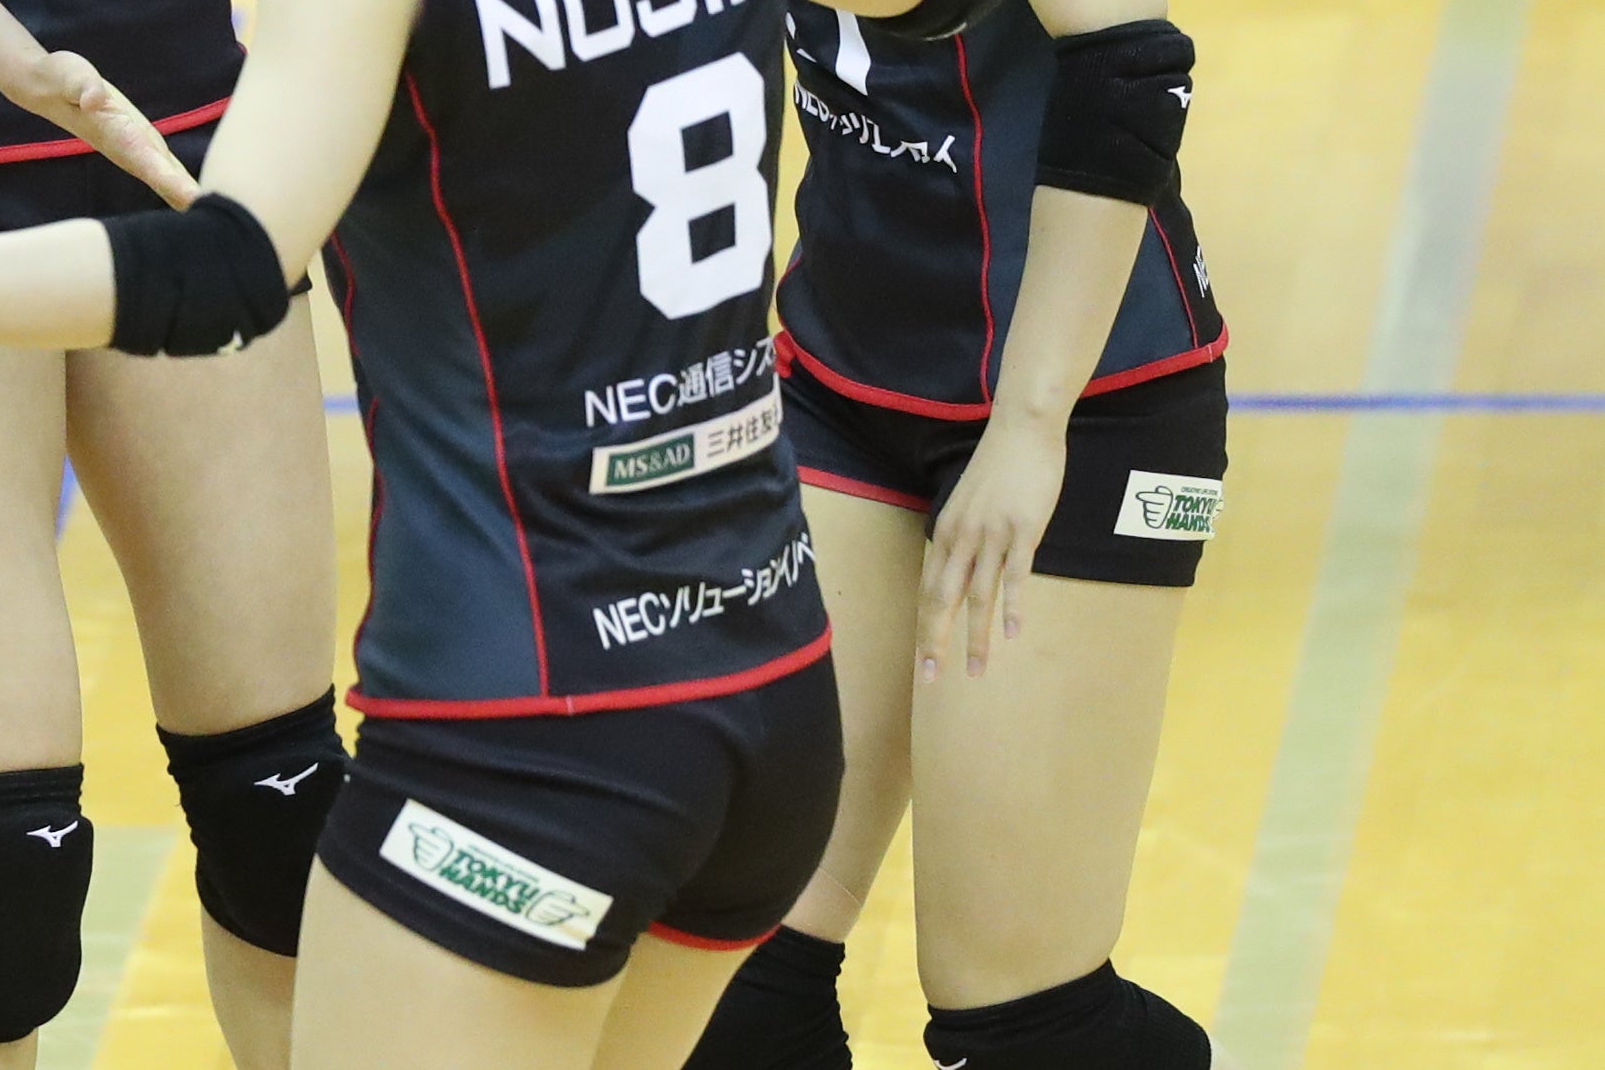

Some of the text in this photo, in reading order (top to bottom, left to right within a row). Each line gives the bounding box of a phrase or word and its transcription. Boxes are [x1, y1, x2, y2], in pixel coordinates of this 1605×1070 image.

[628, 51, 772, 320] 8
[439, 866, 525, 914] HANDS
[453, 849, 541, 900] TOKYU
